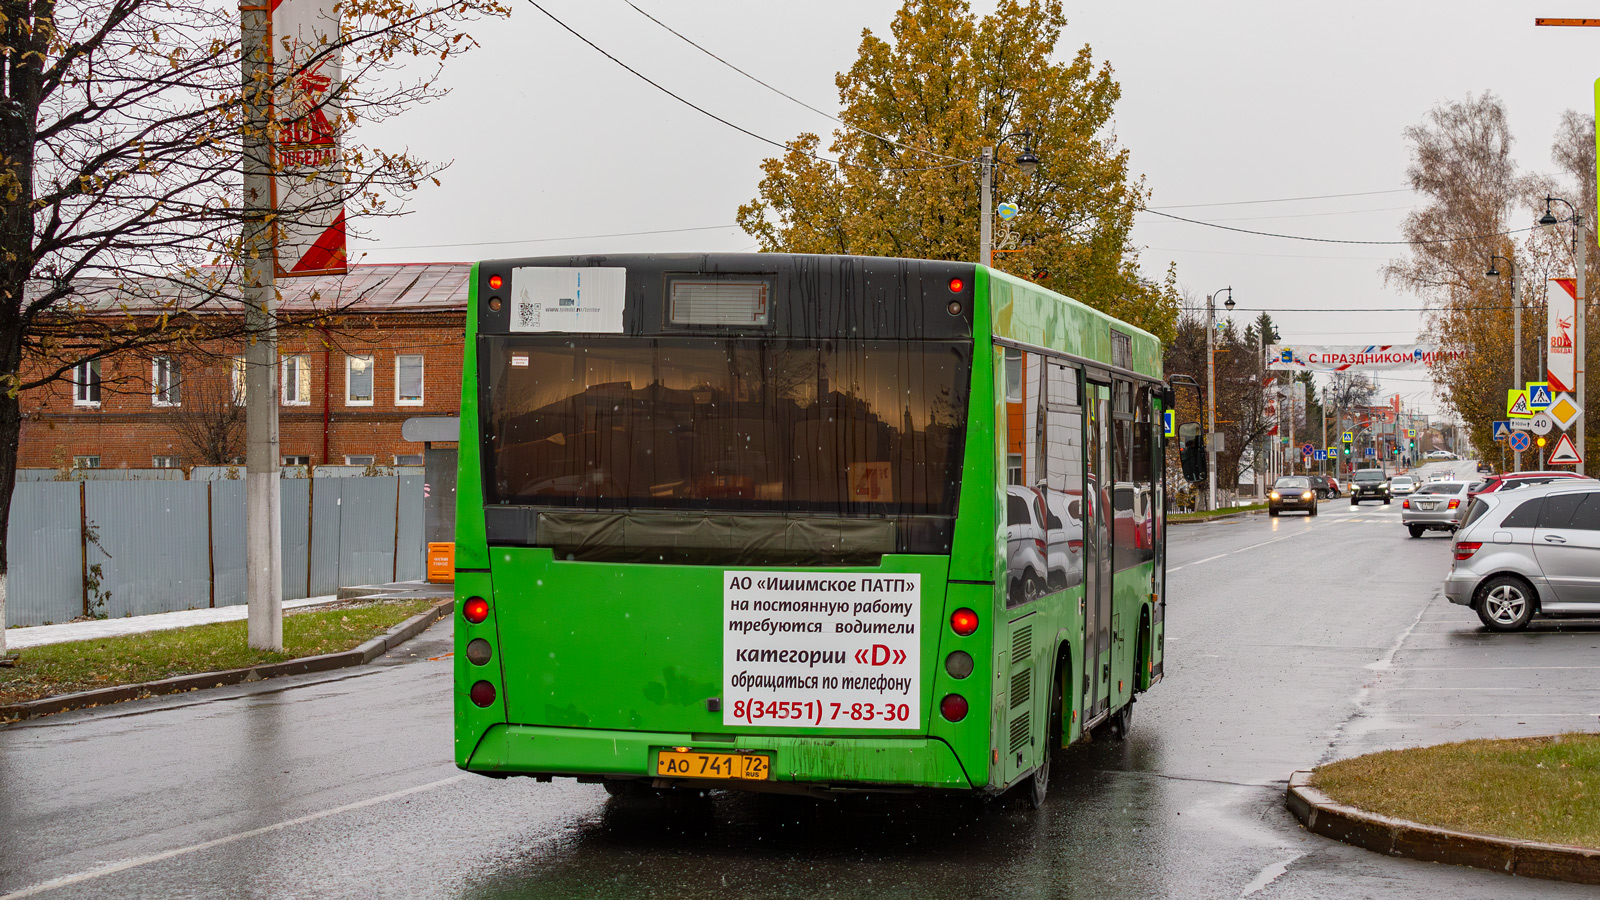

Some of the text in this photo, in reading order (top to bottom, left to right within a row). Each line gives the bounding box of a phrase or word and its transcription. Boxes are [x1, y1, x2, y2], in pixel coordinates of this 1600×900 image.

[279, 148, 337, 167] ПОБЕДА!
[1550, 336, 1563, 347] 80
[1308, 353, 1318, 363] С
[1321, 352, 1418, 365] ПРАЗДНИКОМ,
[1534, 419, 1547, 428] 40
[729, 576, 915, 593] АО «Ишимское ПАТП»
[730, 599, 913, 617] на постоянную работу
[728, 618, 915, 636] требуются водители
[736, 643, 908, 668] категории «D»
[731, 670, 912, 695] обращаться по телефону
[733, 697, 910, 726] 8(34551) 7-83-30
[666, 756, 763, 775] АО 741 72
